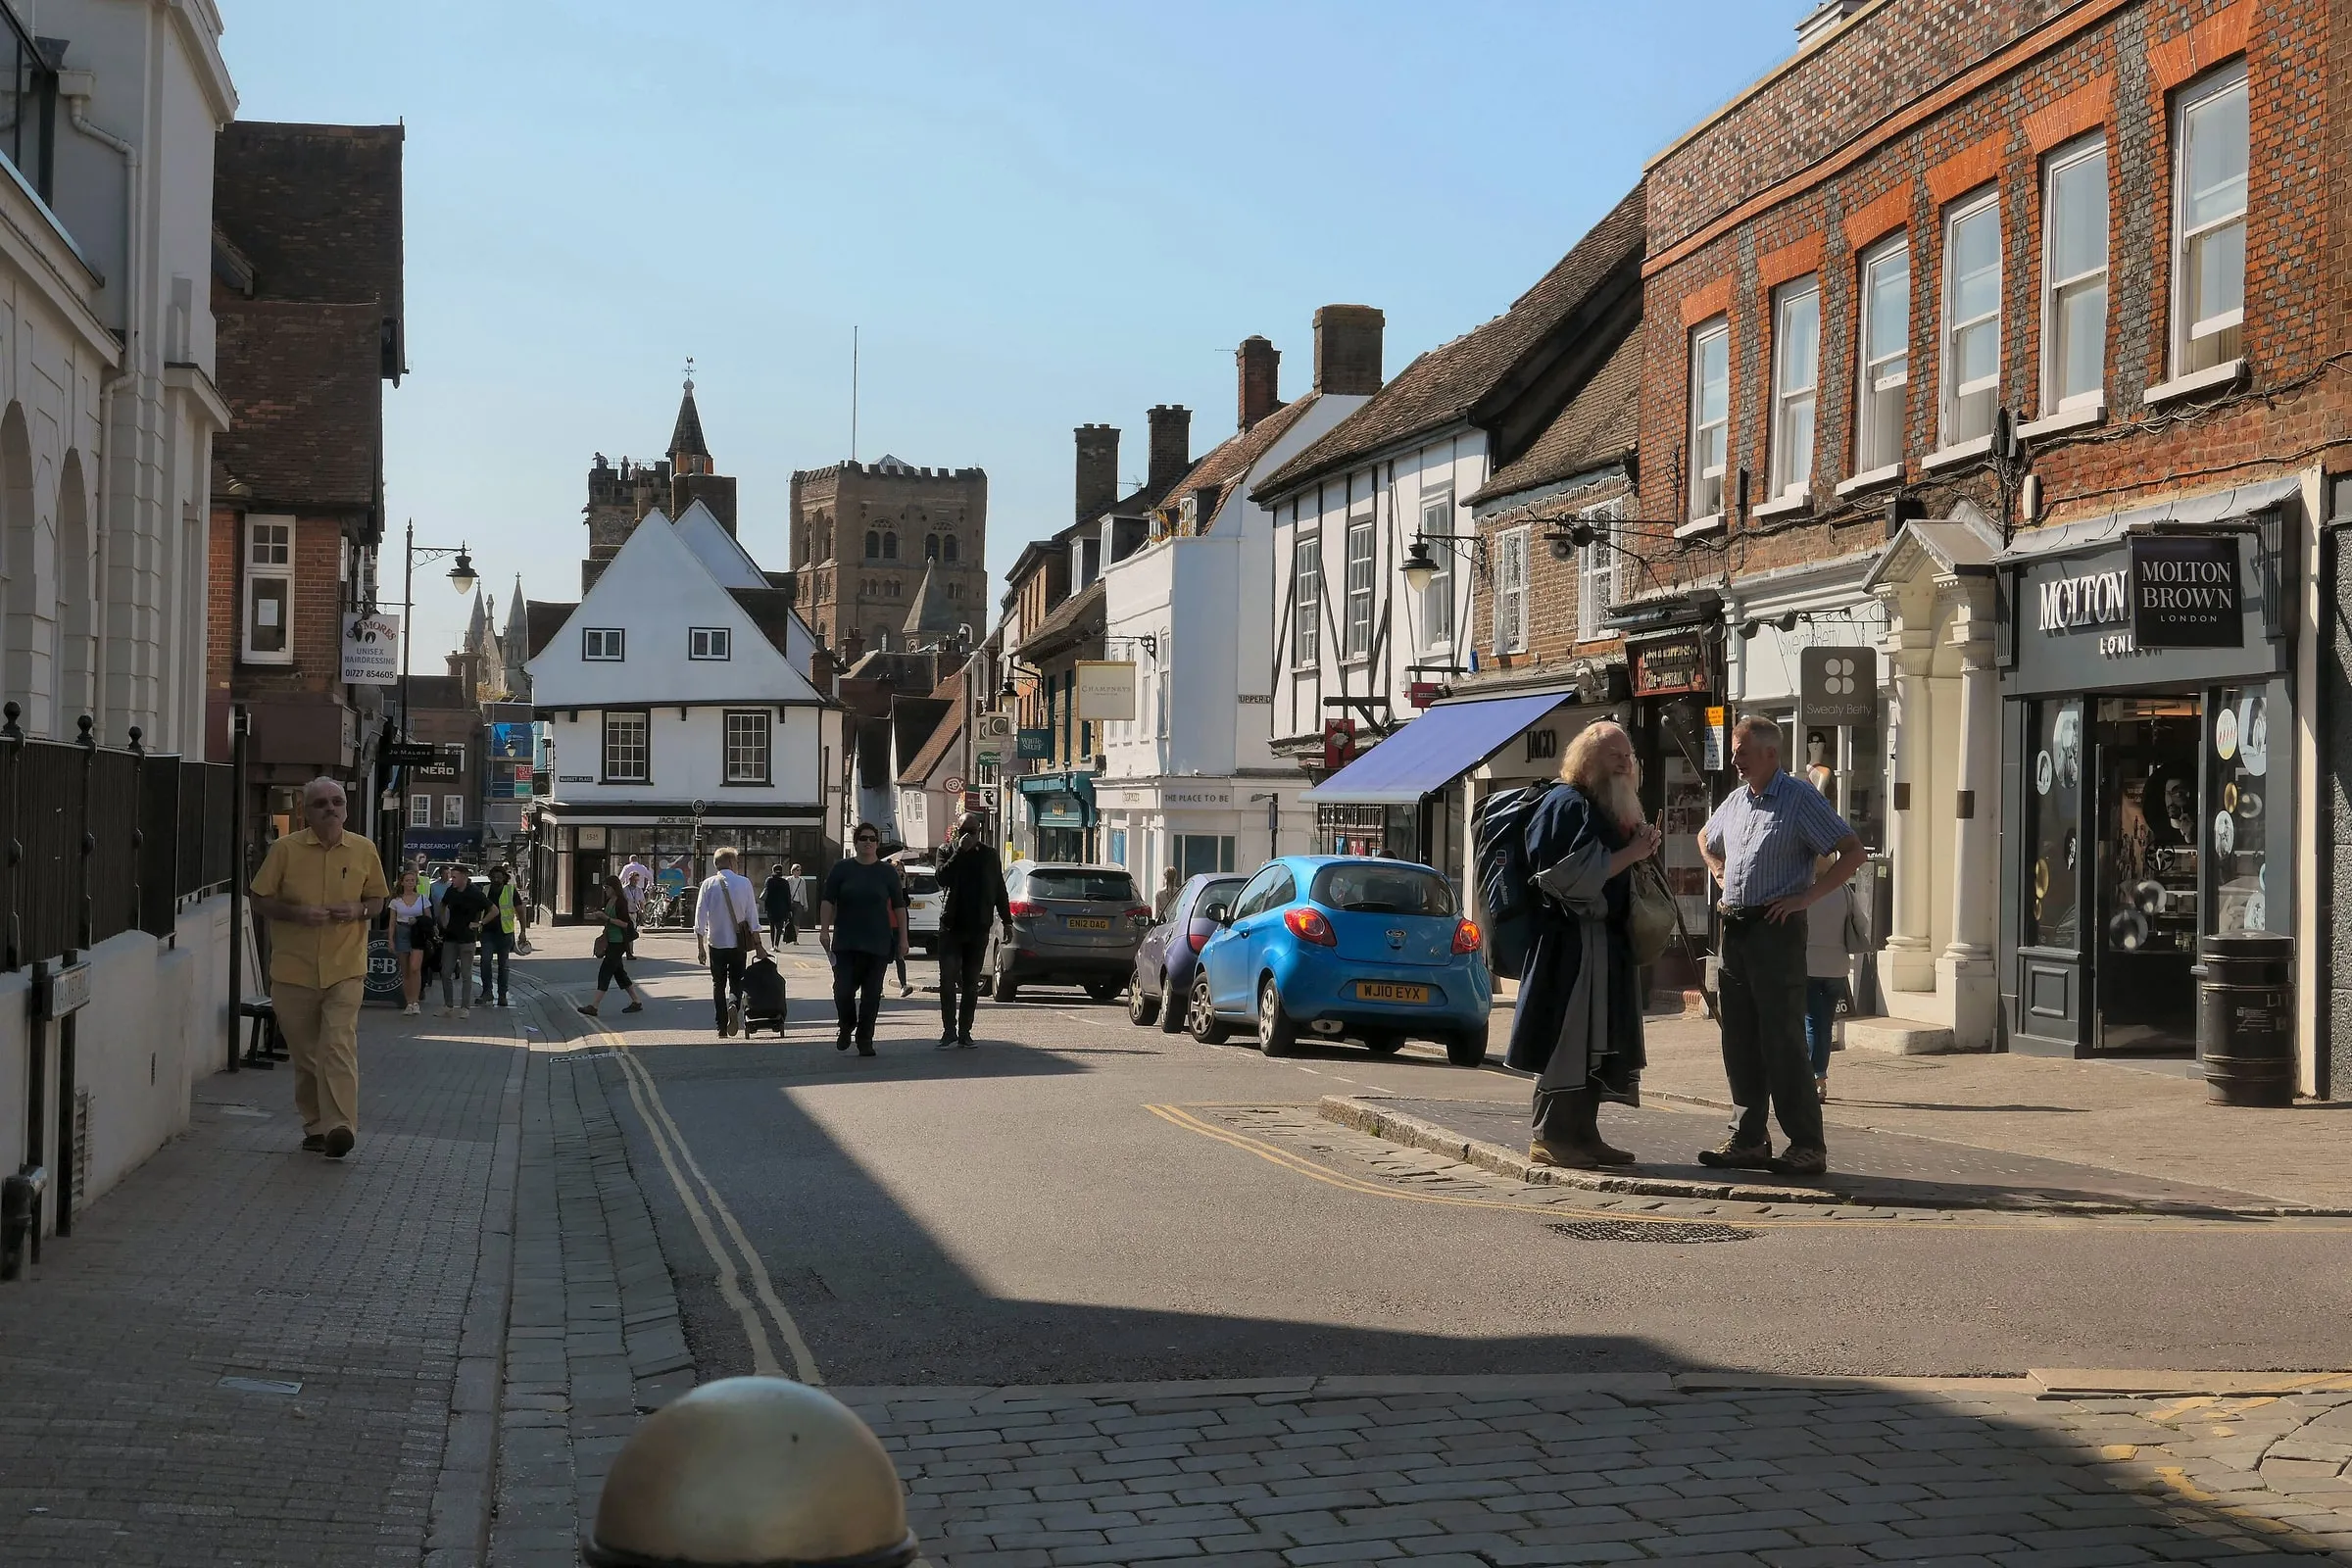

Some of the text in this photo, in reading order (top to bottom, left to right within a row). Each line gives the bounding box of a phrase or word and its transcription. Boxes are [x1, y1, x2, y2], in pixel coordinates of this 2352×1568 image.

[2141, 562, 2231, 583] MOLTON
[2038, 569, 2129, 631] MOLTON
[2142, 588, 2232, 609] BROWN
[356, 647, 384, 656] UNISEX
[344, 656, 396, 665] HAIRDRESSING
[345, 668, 394, 679] 01727 854605
[1239, 695, 1264, 704] UPPER
[1806, 703, 1872, 716] Sweaty Betty
[1525, 729, 1558, 762] JAGO
[419, 765, 455, 775] NERO
[1364, 985, 1420, 1000] WJ10 EYX
